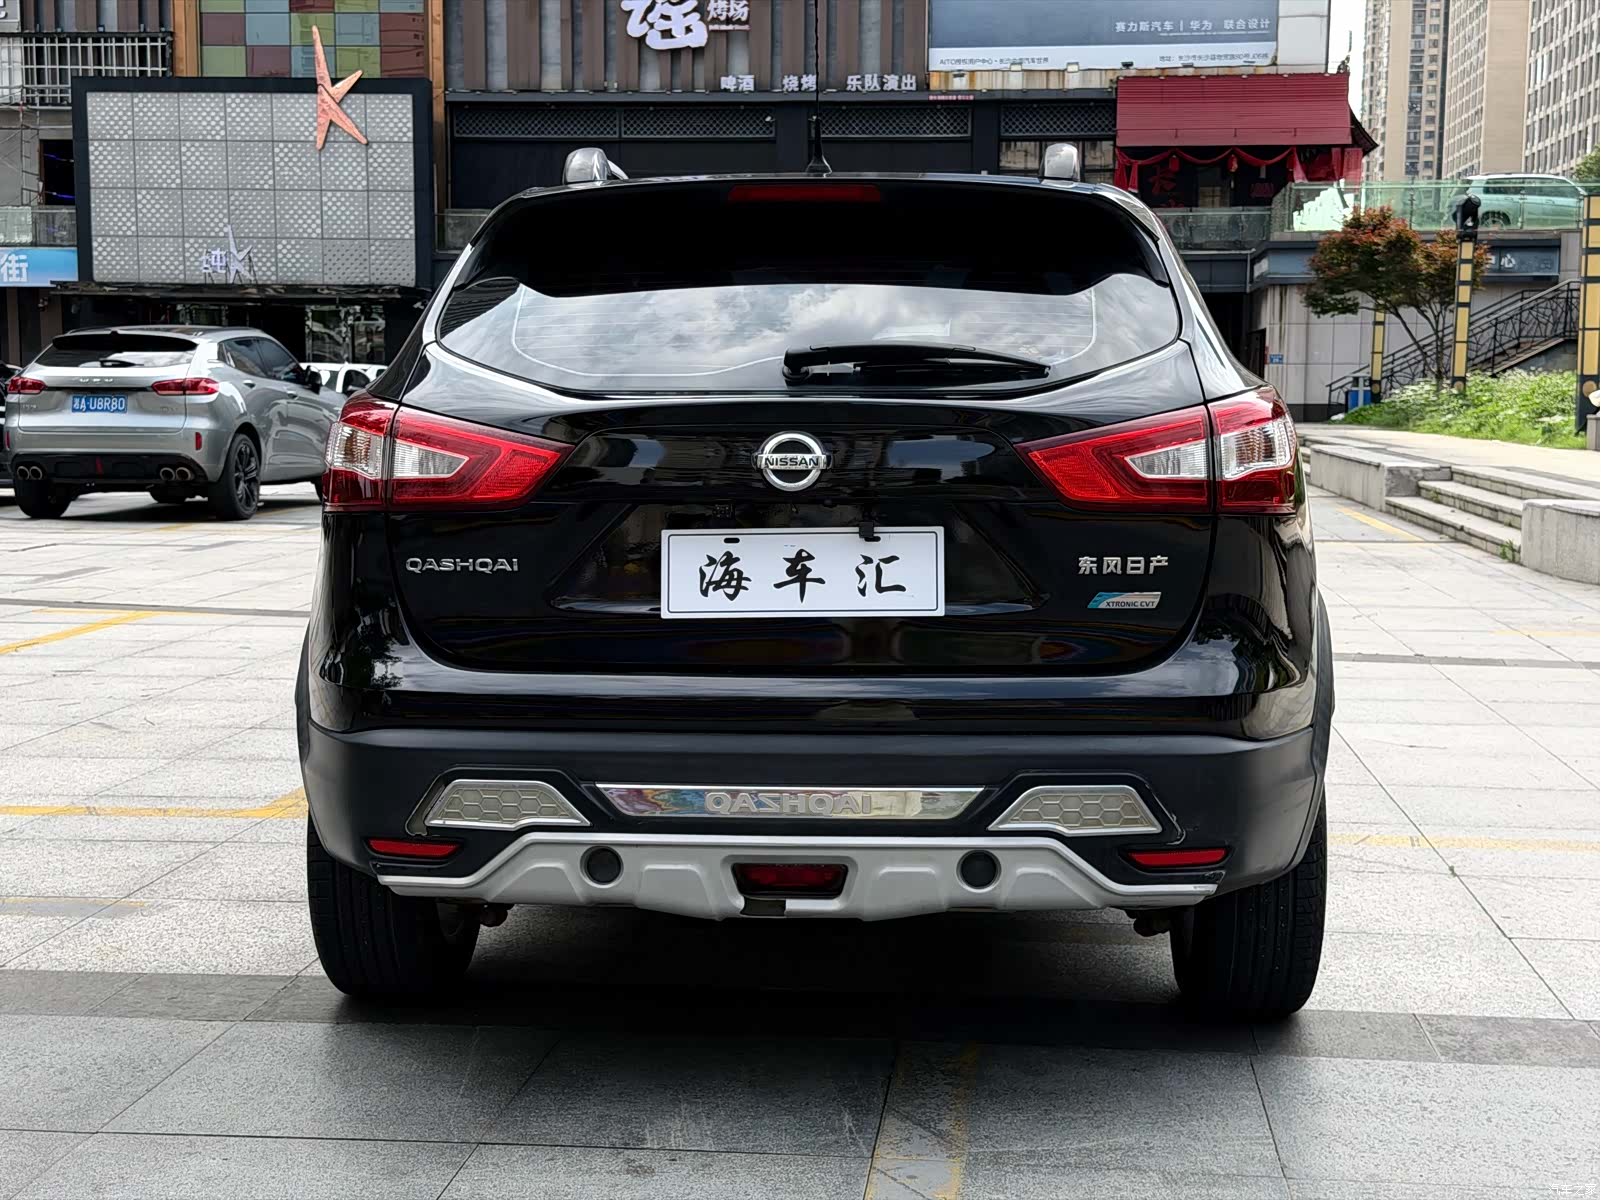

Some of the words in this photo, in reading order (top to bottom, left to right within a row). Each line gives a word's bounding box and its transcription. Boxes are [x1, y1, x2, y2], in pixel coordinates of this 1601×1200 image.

[1115, 20, 1174, 33] 赛力斯汽车
[1190, 19, 1213, 31] 华为
[1223, 19, 1271, 31] 联合设计
[720, 75, 755, 92] 啤酒
[782, 75, 817, 92] 烧烤
[846, 74, 917, 92] 乐队演出
[0, 253, 29, 283] 街
[764, 457, 819, 467] NISSAN
[405, 557, 519, 574] QASHQAI
[1078, 555, 1169, 575] 东风日产
[699, 548, 907, 603] 海车汇
[705, 792, 872, 816] QASHQAI
